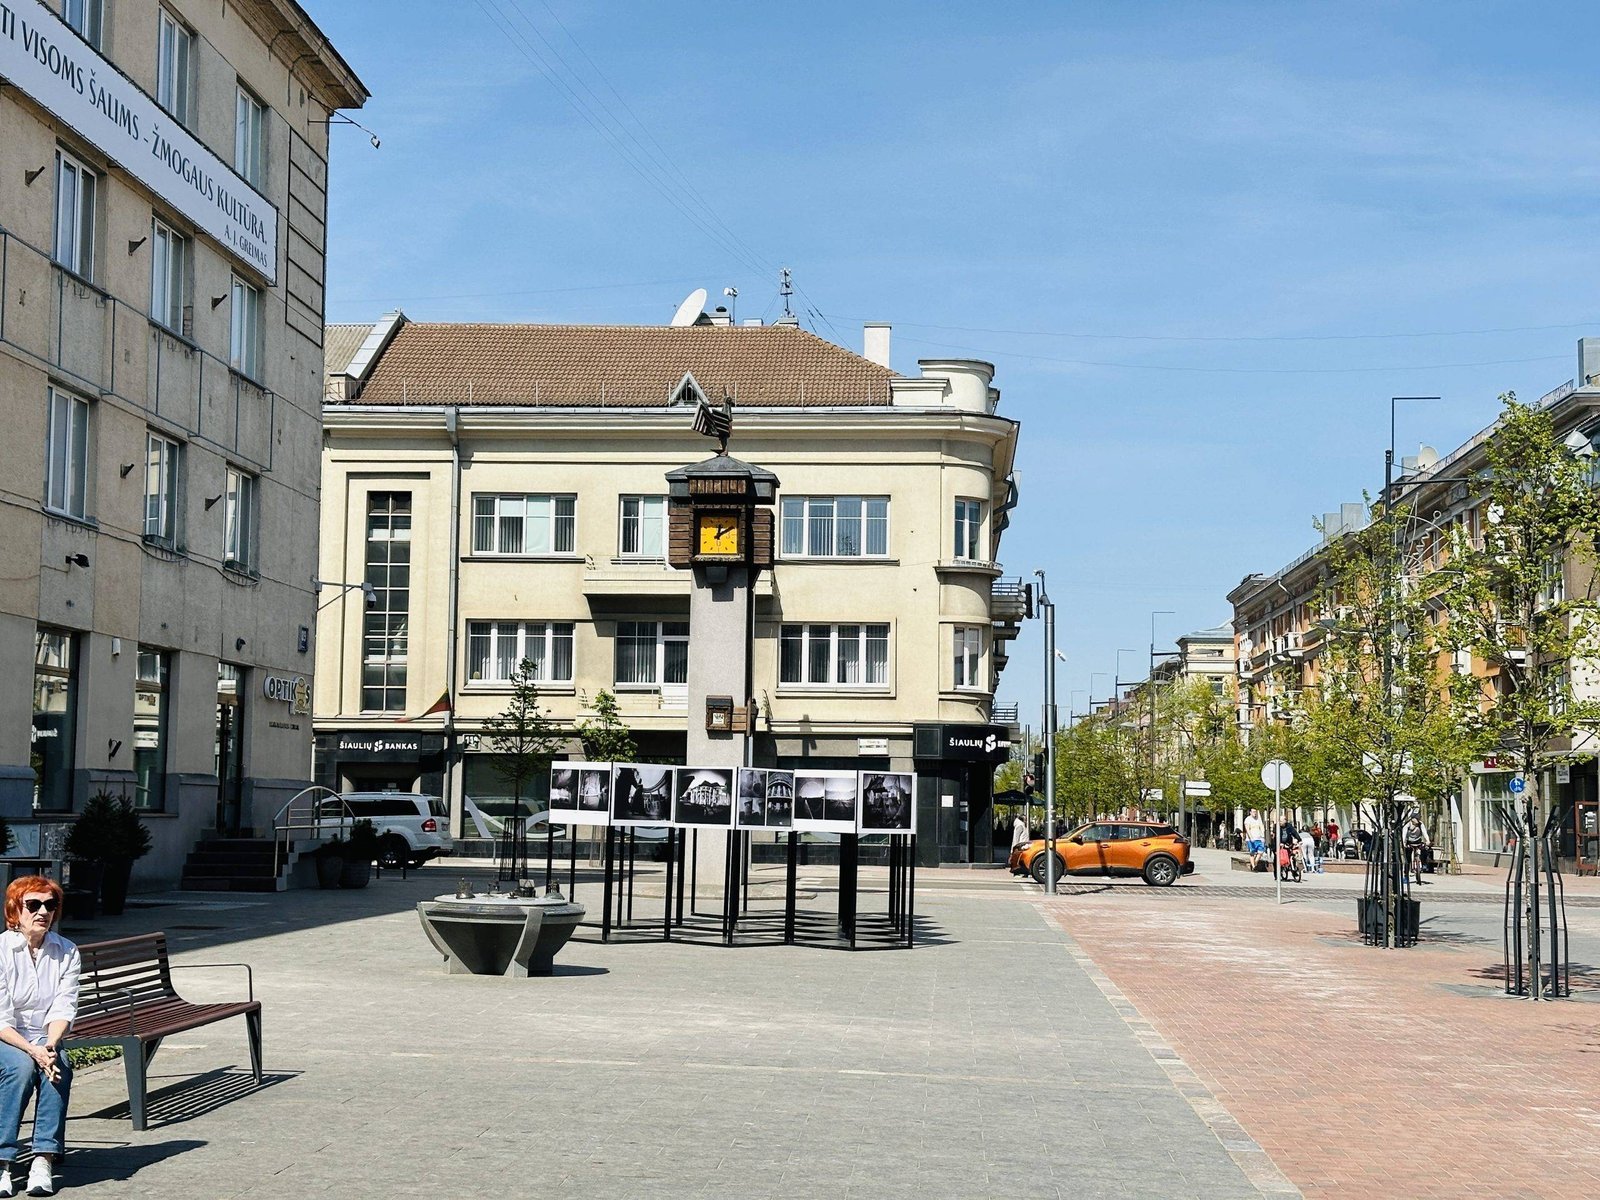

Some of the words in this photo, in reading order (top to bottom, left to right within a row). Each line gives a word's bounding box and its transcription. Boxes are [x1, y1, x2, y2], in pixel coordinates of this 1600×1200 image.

[21, 20, 84, 94] VISOMS
[89, 68, 139, 140] ŠALIMS
[151, 123, 213, 201] ŽMOGAUS
[217, 185, 267, 245] KULTŪRA.
[239, 235, 267, 268] GREIMAS
[339, 740, 372, 750] ŠIAULIŲ
[384, 742, 418, 750] BANKAS
[949, 737, 983, 748] ŠIAULIŲ
